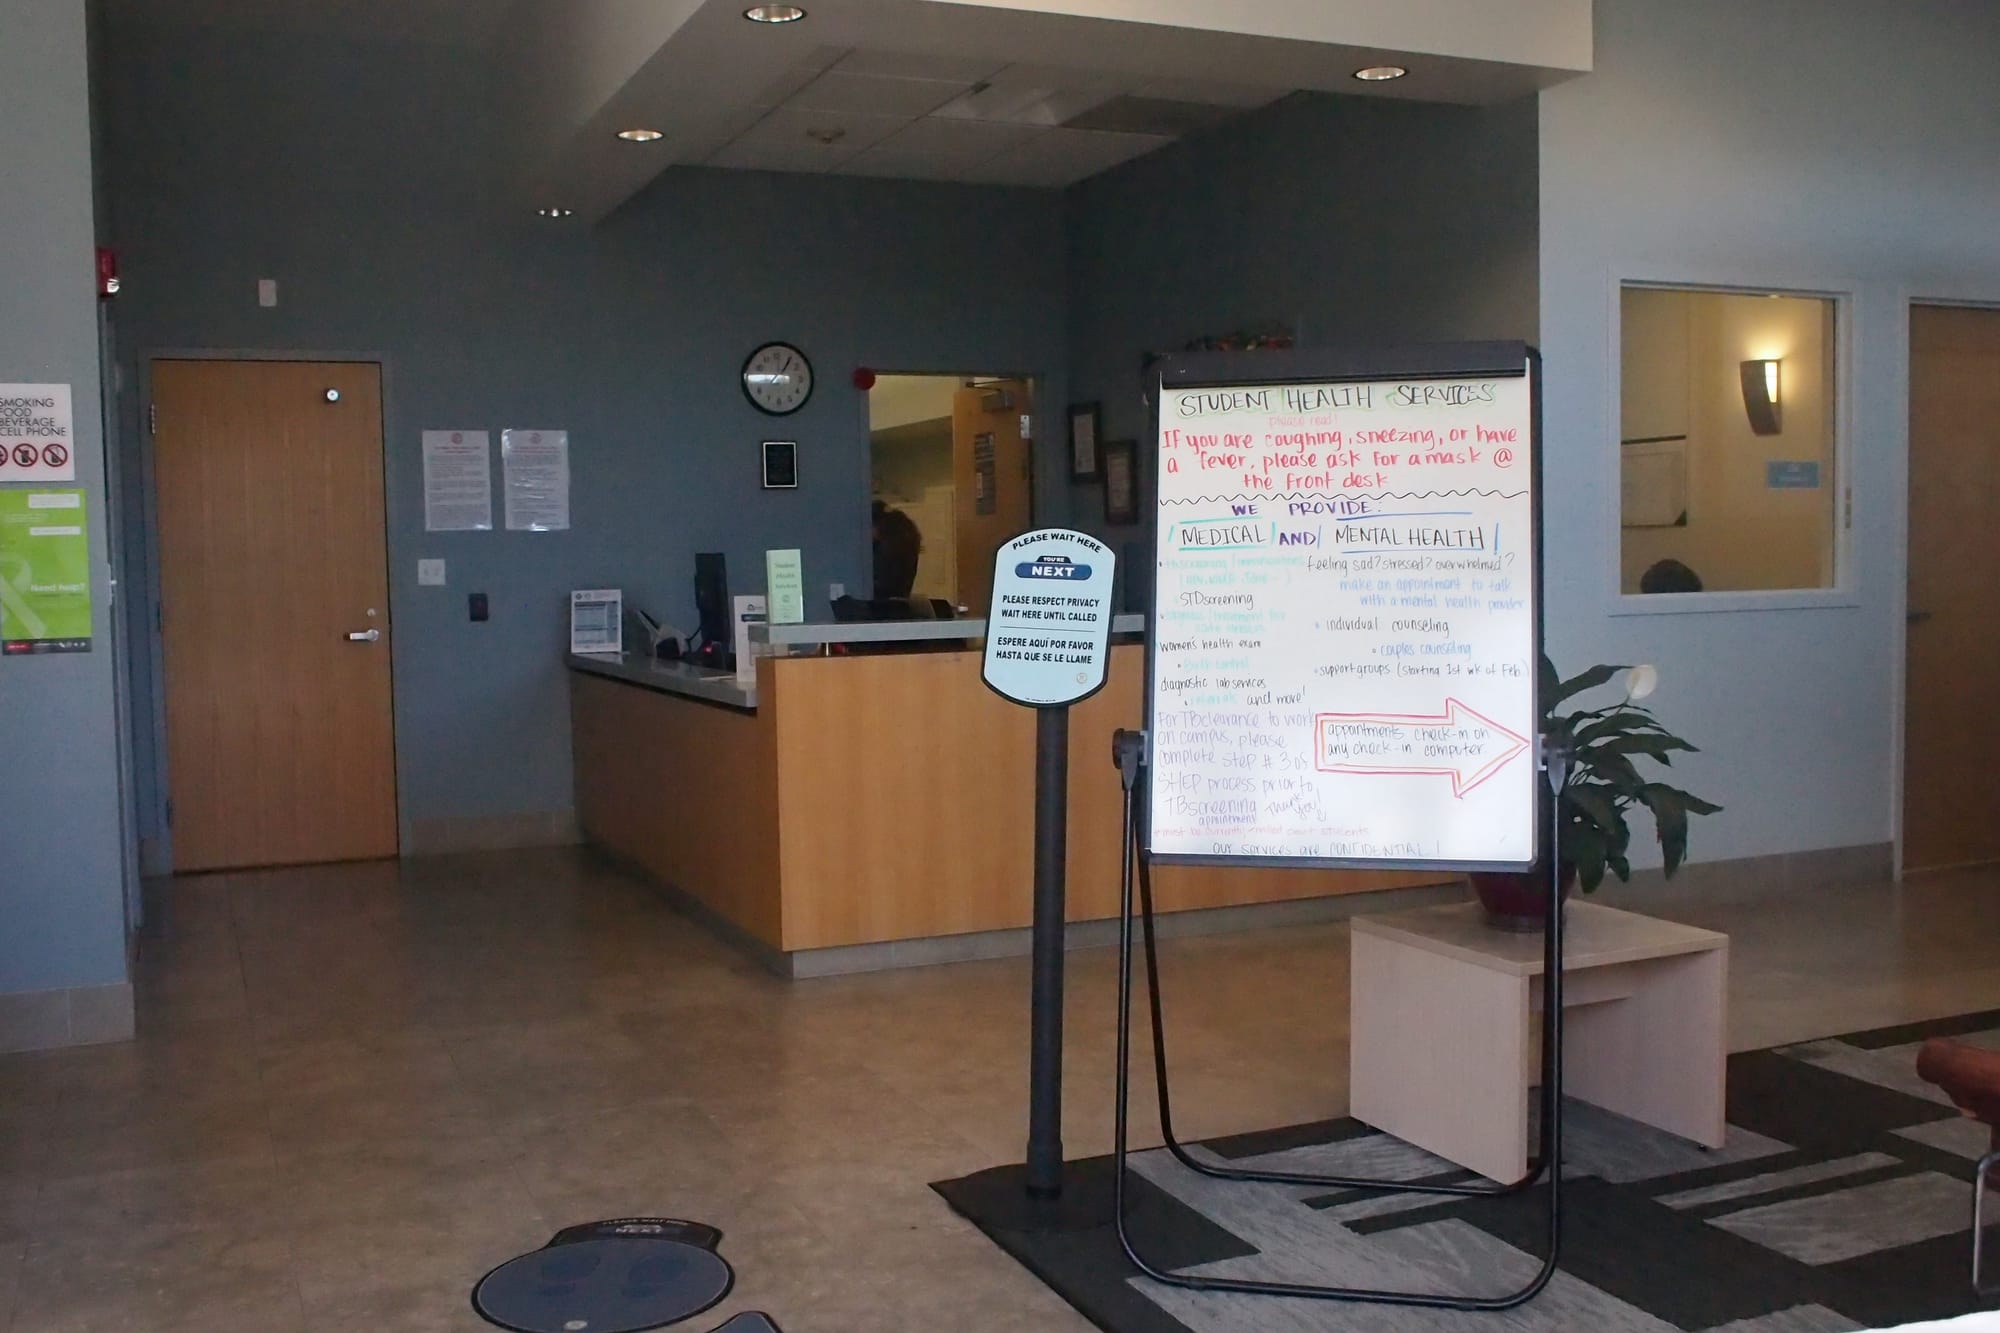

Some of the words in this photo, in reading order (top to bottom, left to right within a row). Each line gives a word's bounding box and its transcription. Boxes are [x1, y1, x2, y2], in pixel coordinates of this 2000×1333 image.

[1180, 389, 1271, 416] STUDENT
[1287, 385, 1371, 413] HEALTH
[1397, 383, 1492, 406] SERVICES
[0, 427, 22, 437] CELL
[26, 427, 67, 437] PHONE
[1162, 429, 1180, 449] If
[1186, 434, 1218, 455] you
[1224, 435, 1254, 449] are
[1356, 427, 1443, 451] sneezing,
[1450, 429, 1468, 443] or
[1476, 424, 1517, 444] have
[1167, 457, 1180, 474] a
[1263, 452, 1317, 476] please
[1326, 450, 1361, 468] ask
[1374, 451, 1400, 467] for
[1493, 447, 1513, 469] @
[1243, 471, 1273, 490] the
[1286, 471, 1334, 491] front
[1343, 472, 1388, 489] desk
[1232, 503, 1258, 516] WE
[1012, 533, 1048, 550] PLEASE
[1051, 533, 1075, 541] WAIT
[1077, 536, 1101, 553] HERE
[1181, 525, 1267, 546] MEDICAL
[1279, 531, 1316, 546] AND
[1335, 524, 1403, 546] MENTAL
[1408, 526, 1485, 549] HEALTH
[1031, 566, 1075, 578] NEXT
[1307, 555, 1347, 577] feeling
[1340, 578, 1373, 593] make
[1377, 580, 1391, 592] an
[1396, 578, 1461, 595] appointment
[1471, 578, 1483, 592] to
[1488, 577, 1512, 592] talk
[1002, 595, 1030, 605] PLEASE
[1032, 596, 1065, 607] RESPECT
[1067, 598, 1100, 608] PRIVACY
[1360, 594, 1386, 608] with
[1001, 609, 1020, 619] WAIT
[1022, 610, 1042, 620] HERE
[1044, 611, 1066, 621] UNTIL
[1068, 612, 1097, 622] CALLED
[1327, 616, 1378, 632] individual
[1391, 617, 1449, 638] counseling
[998, 636, 1026, 647] ESPERE
[1029, 636, 1049, 649] AQUÍ
[1050, 640, 1066, 649] POR
[1068, 640, 1093, 650] FAVOR
[1202, 637, 1233, 650] health
[1381, 643, 1415, 659] couples
[996, 651, 1022, 661] HASTA
[1024, 652, 1040, 662] QUE
[1042, 653, 1052, 662] SE
[1054, 654, 1064, 663] LE
[1066, 655, 1092, 665] LLAME
[1161, 675, 1208, 696] diagnostic
[1247, 691, 1270, 706] and
[1268, 711, 1280, 728] to
[1158, 729, 1175, 746] on
[1239, 732, 1289, 749] please
[1328, 722, 1405, 741] appointments
[1159, 749, 1216, 769] complete
[1221, 752, 1256, 770] step
[1328, 742, 1349, 759] any
[1207, 776, 1257, 796] process
[1300, 775, 1313, 796] to
